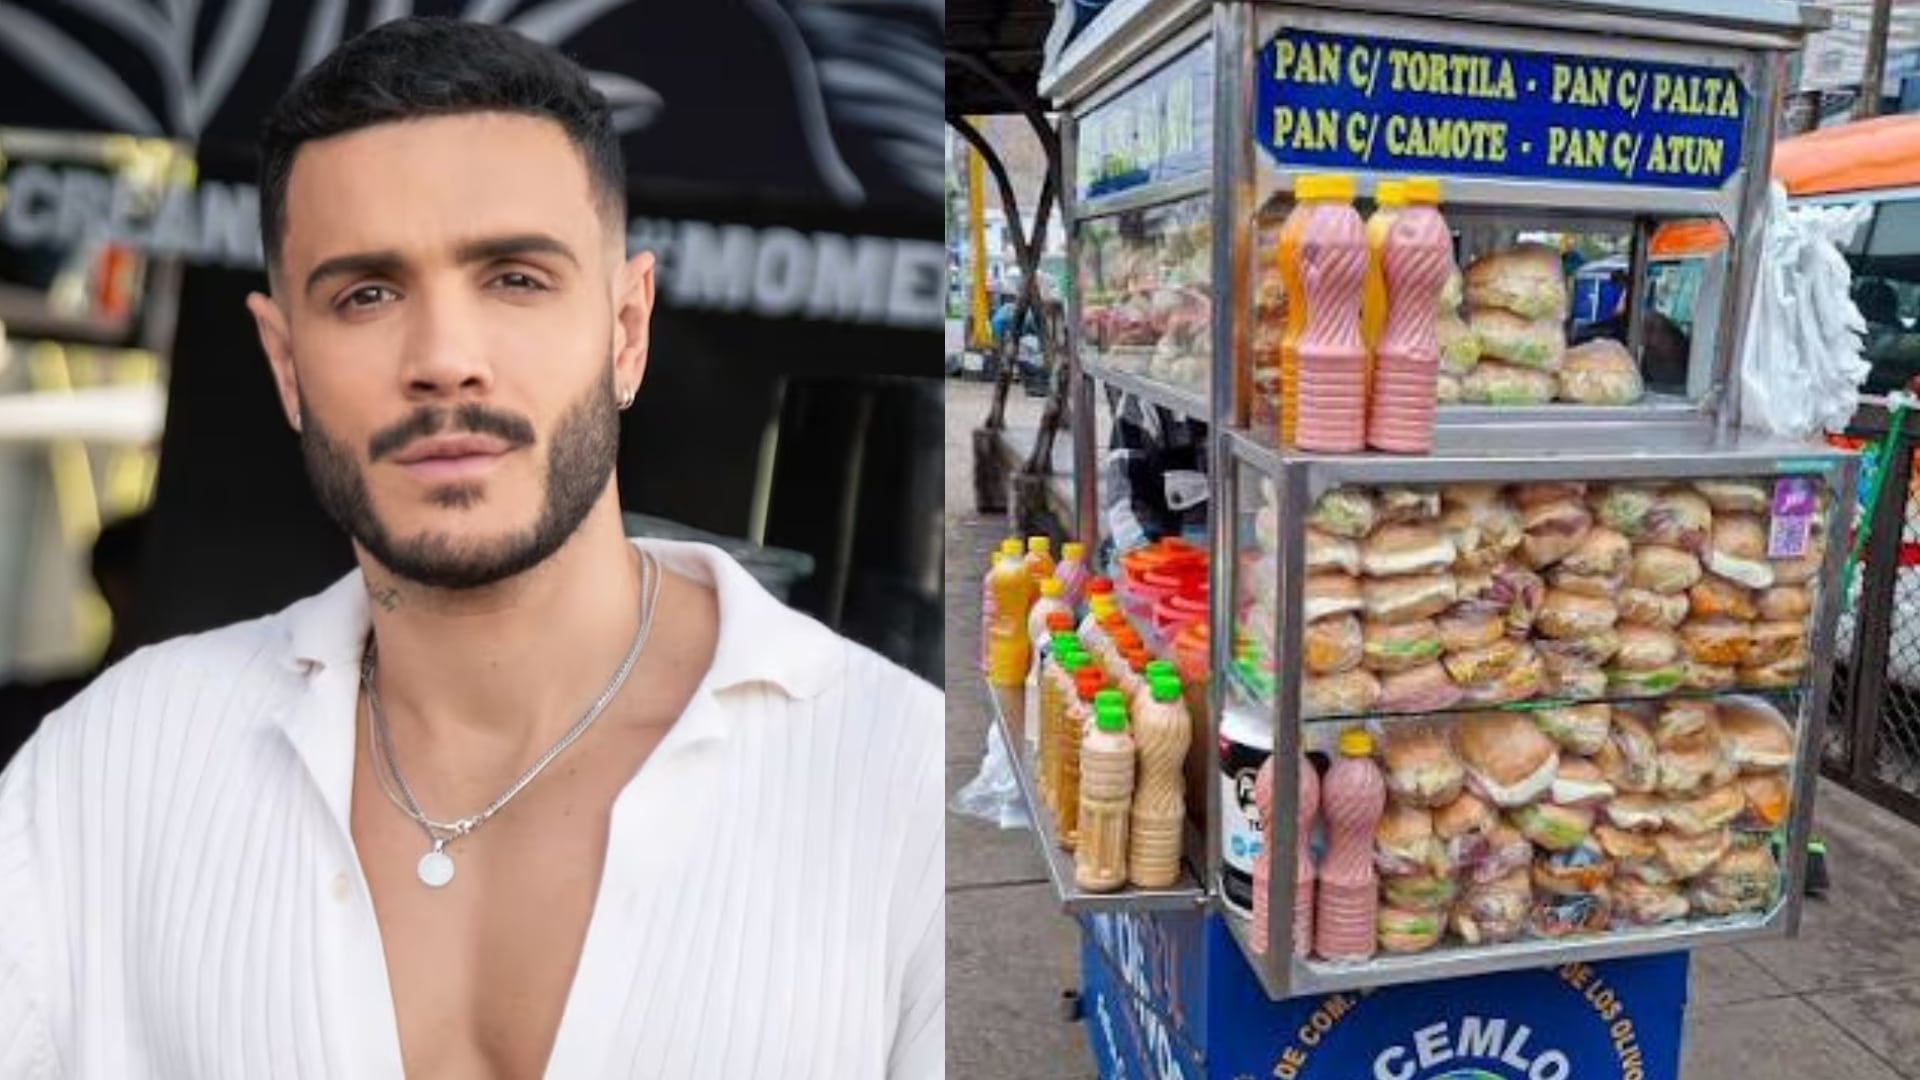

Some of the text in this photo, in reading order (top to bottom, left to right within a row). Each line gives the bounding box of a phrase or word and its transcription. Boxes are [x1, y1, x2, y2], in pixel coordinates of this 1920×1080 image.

[1275, 38, 1739, 118] PAN C/ TORTILA PAN C/ PALTA
[1272, 105, 1724, 179] PAN C/ CAMOTE PAN C/ ATUN
[1584, 979, 1623, 1021] LOS
[1373, 1015, 1570, 1080] CEMLO
